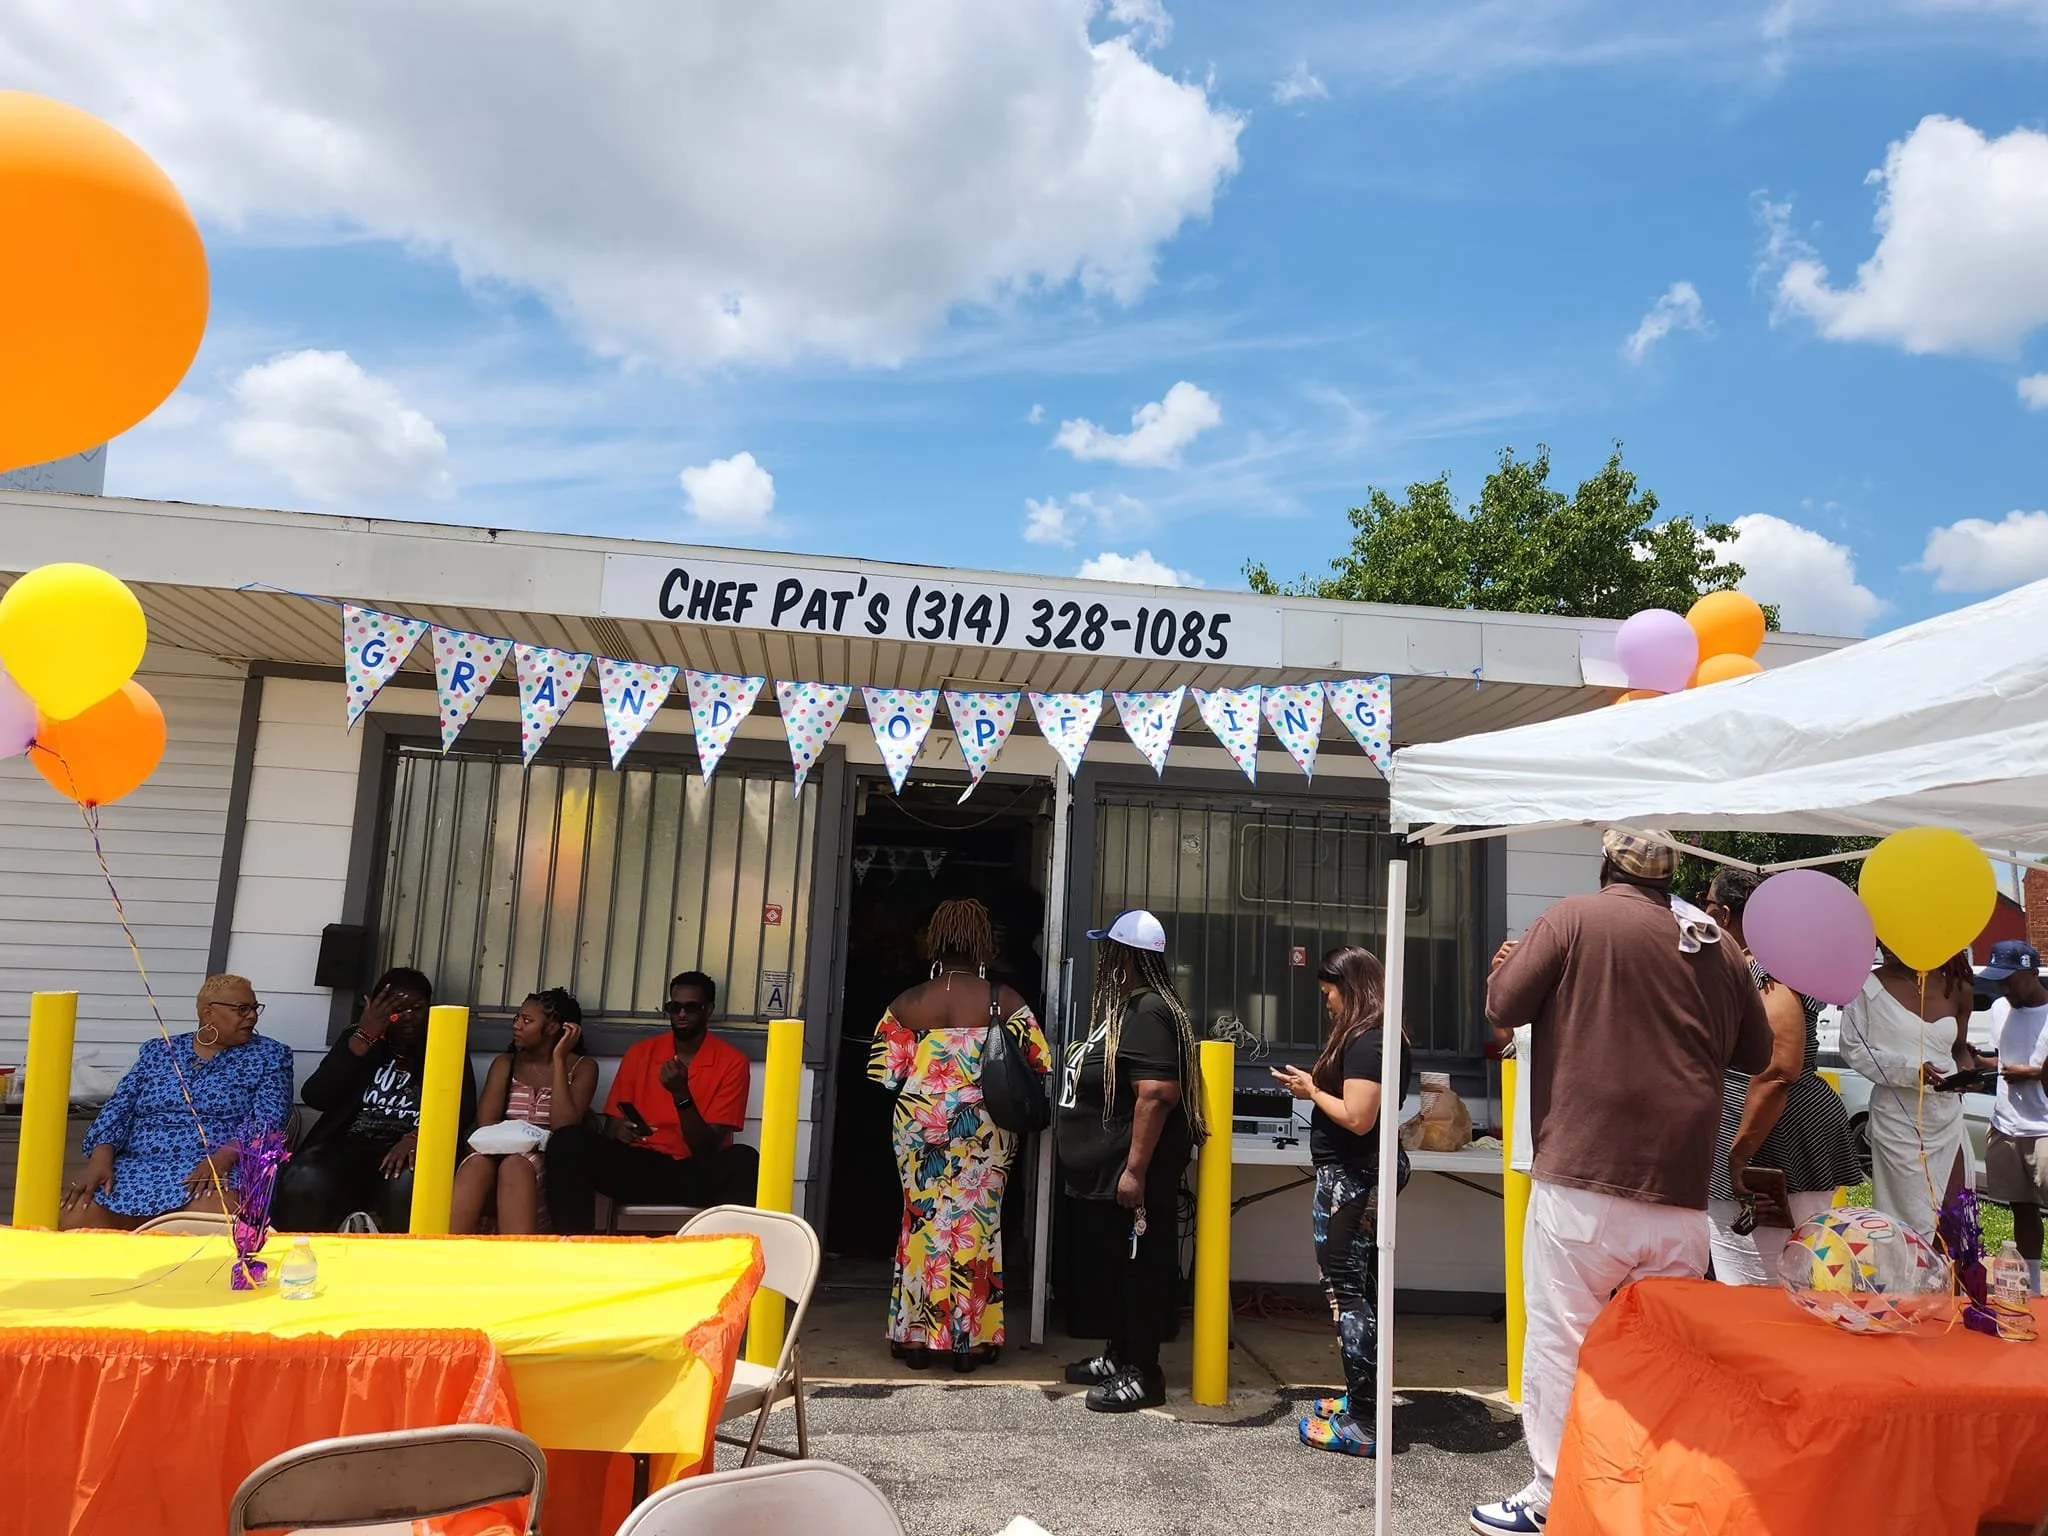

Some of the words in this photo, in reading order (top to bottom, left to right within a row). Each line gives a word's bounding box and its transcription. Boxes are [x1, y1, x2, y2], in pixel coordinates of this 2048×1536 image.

[659, 568, 758, 623] CHEF
[771, 576, 890, 635] PAT'S
[905, 585, 1010, 645] (314)
[1026, 599, 1231, 660] 328-1085
[361, 639, 732, 728] GRAND
[888, 701, 1377, 747] OPENING
[767, 987, 783, 1008] A
